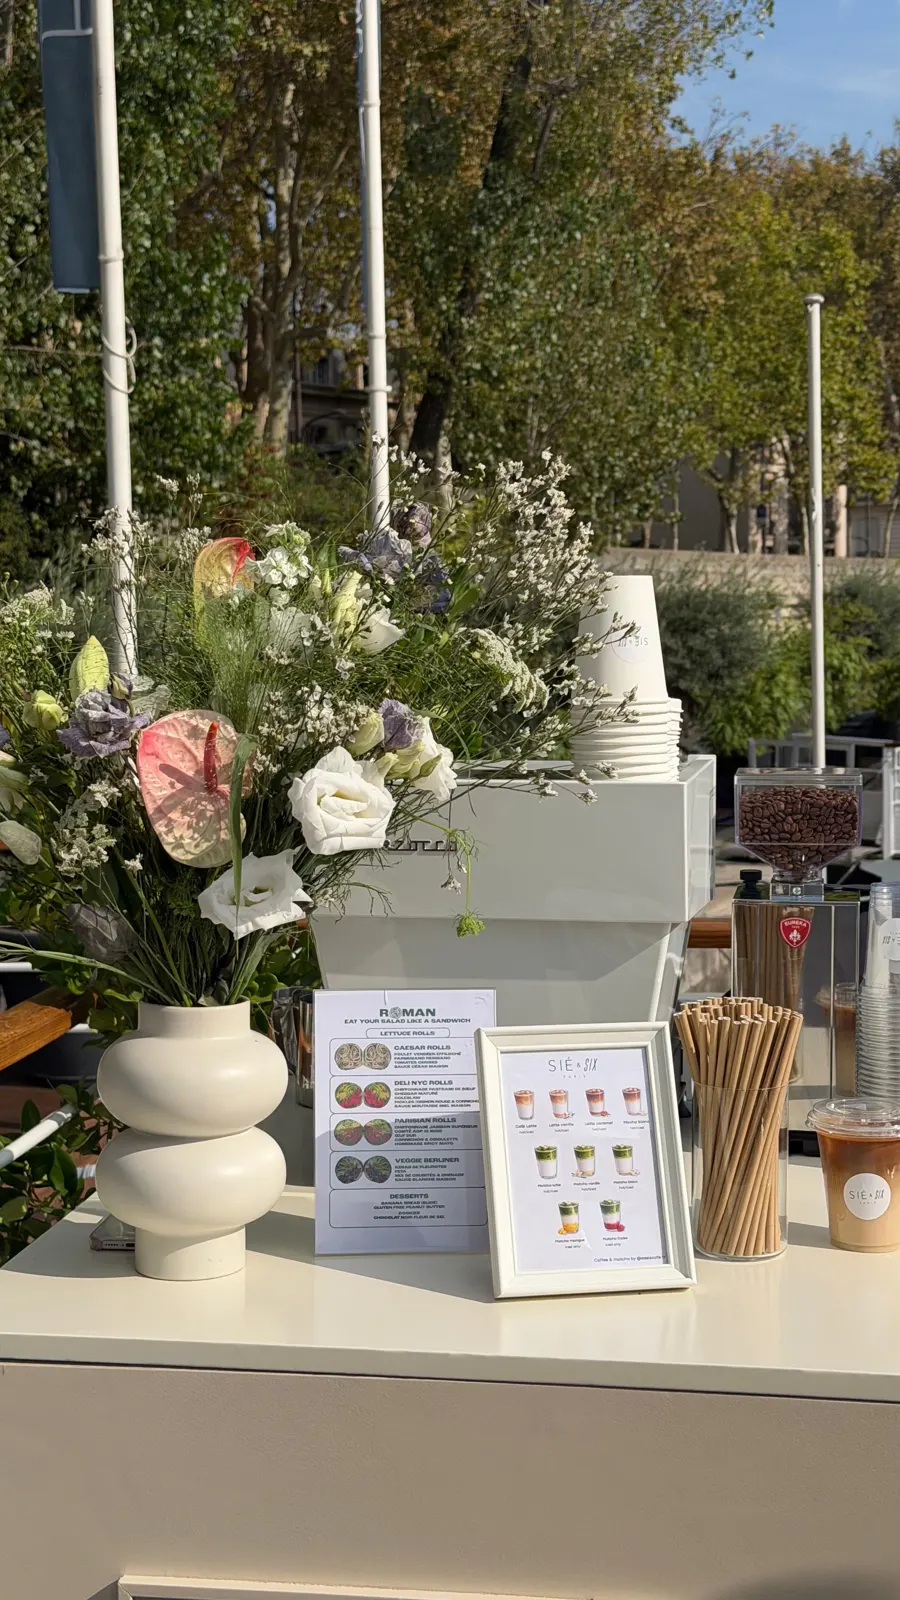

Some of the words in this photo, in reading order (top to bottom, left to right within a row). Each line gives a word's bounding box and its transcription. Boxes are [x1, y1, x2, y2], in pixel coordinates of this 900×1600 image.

[548, 1057, 573, 1072] SIÉ
[584, 1058, 598, 1072] SIX
[849, 1189, 867, 1200] SIÉ
